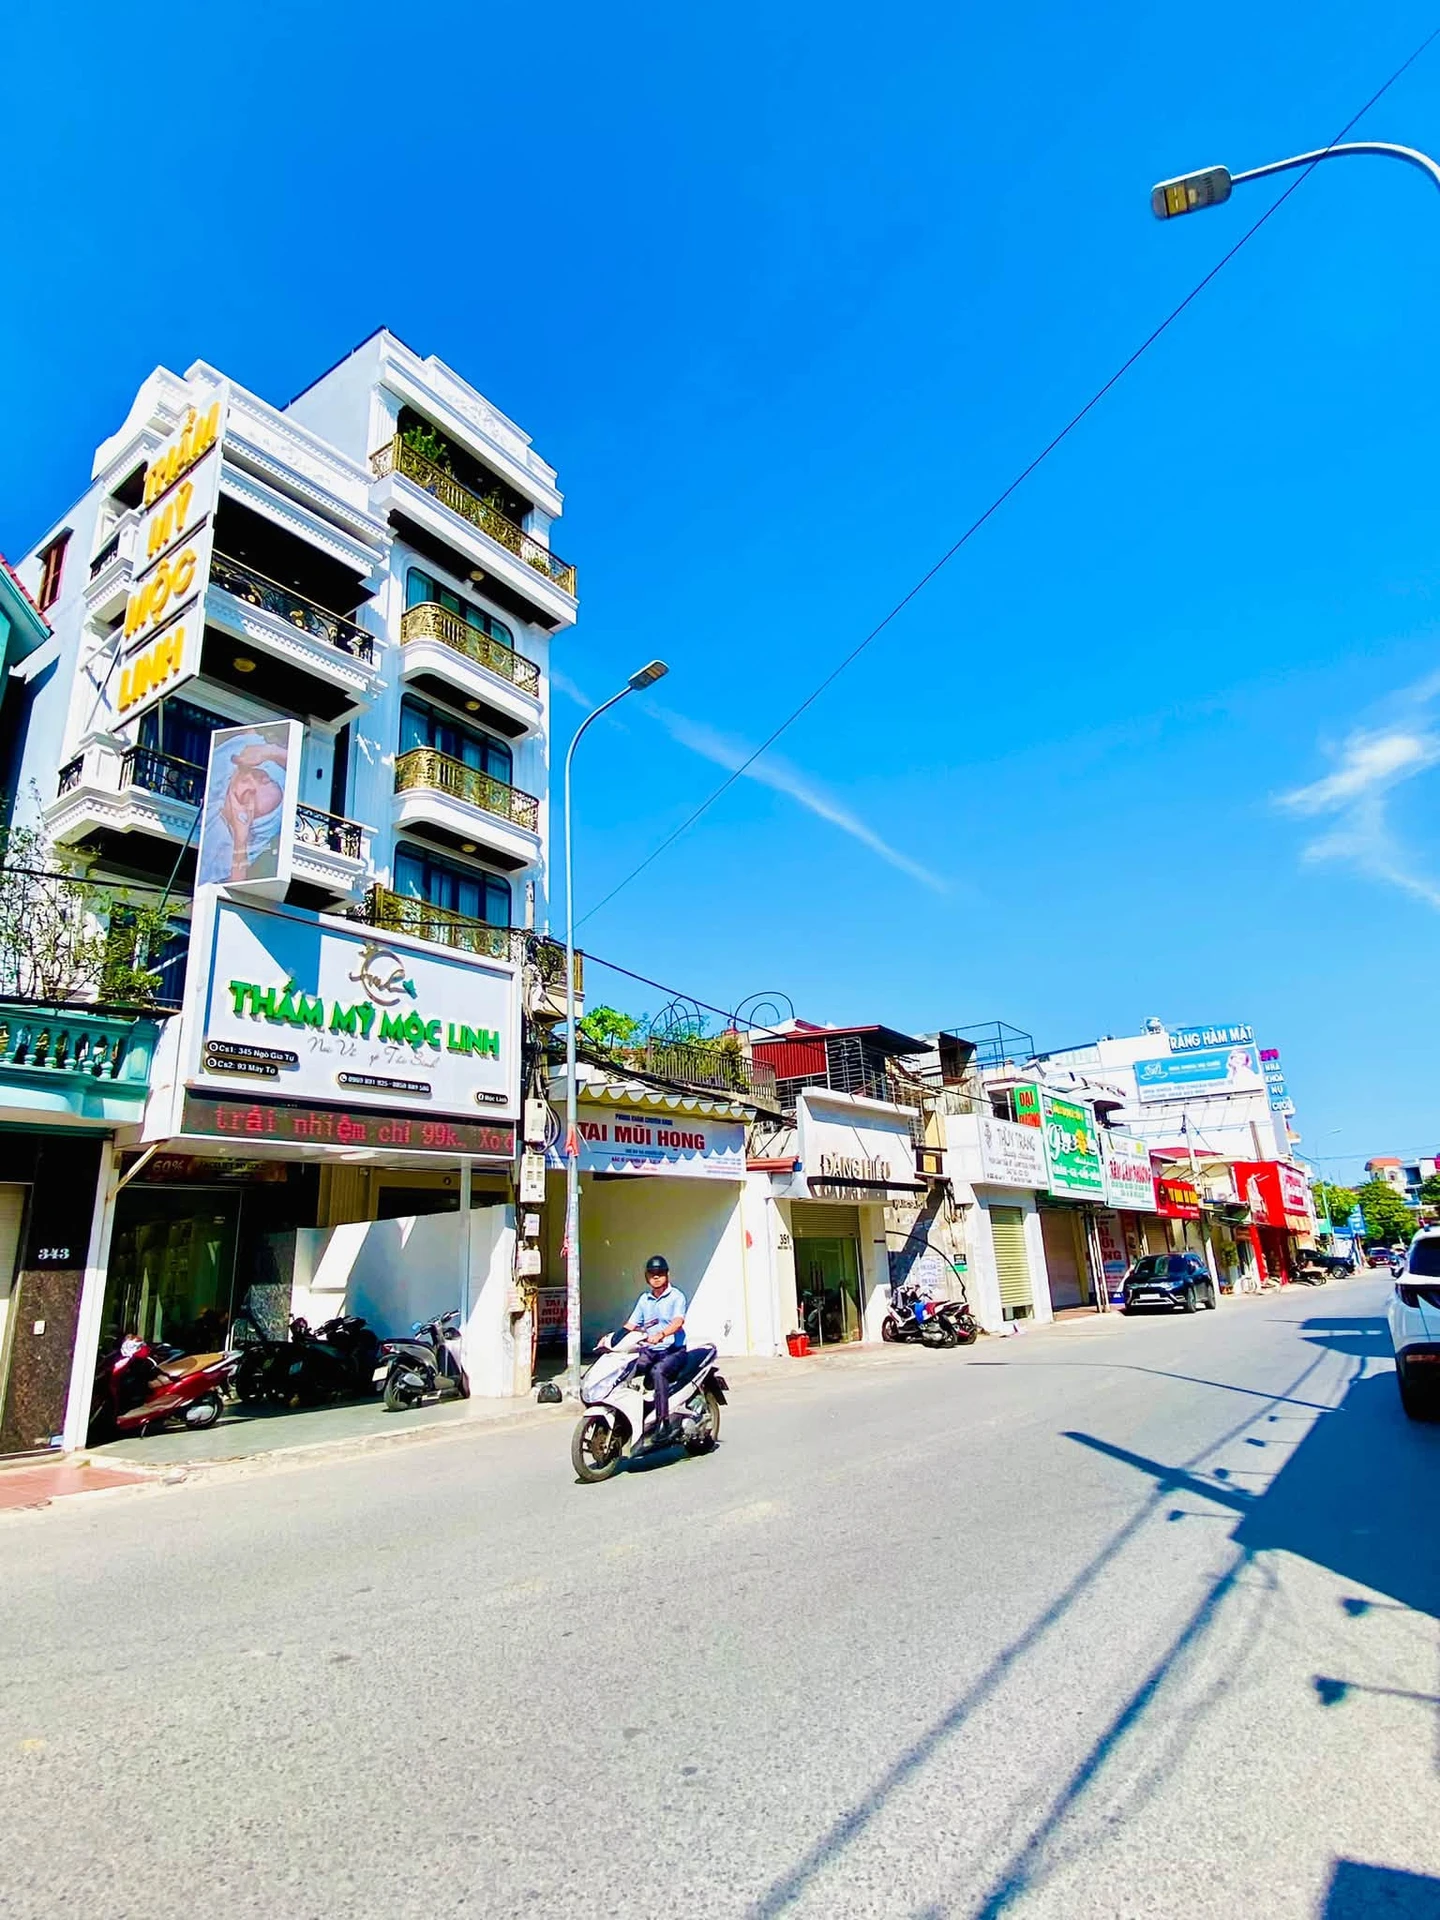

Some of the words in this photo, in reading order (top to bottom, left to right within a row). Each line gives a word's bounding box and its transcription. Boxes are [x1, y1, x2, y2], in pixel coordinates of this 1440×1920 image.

[123, 548, 198, 640] MỘC
[118, 625, 186, 715] LINH
[228, 968, 325, 1029] THẨM
[329, 1001, 376, 1037] MỸ
[378, 1010, 443, 1051] MỘC
[447, 1022, 501, 1058] LINH
[1169, 1033, 1200, 1051] RĂNG
[1203, 1027, 1227, 1045] HÀM
[1230, 1023, 1254, 1044] MẶT
[270, 1052, 284, 1060] Gia
[577, 1121, 607, 1142] TAI
[614, 1125, 651, 1145] MŨI
[657, 1130, 705, 1151] HỌNG
[779, 1233, 789, 1245] 351
[38, 1248, 70, 1260] 343
